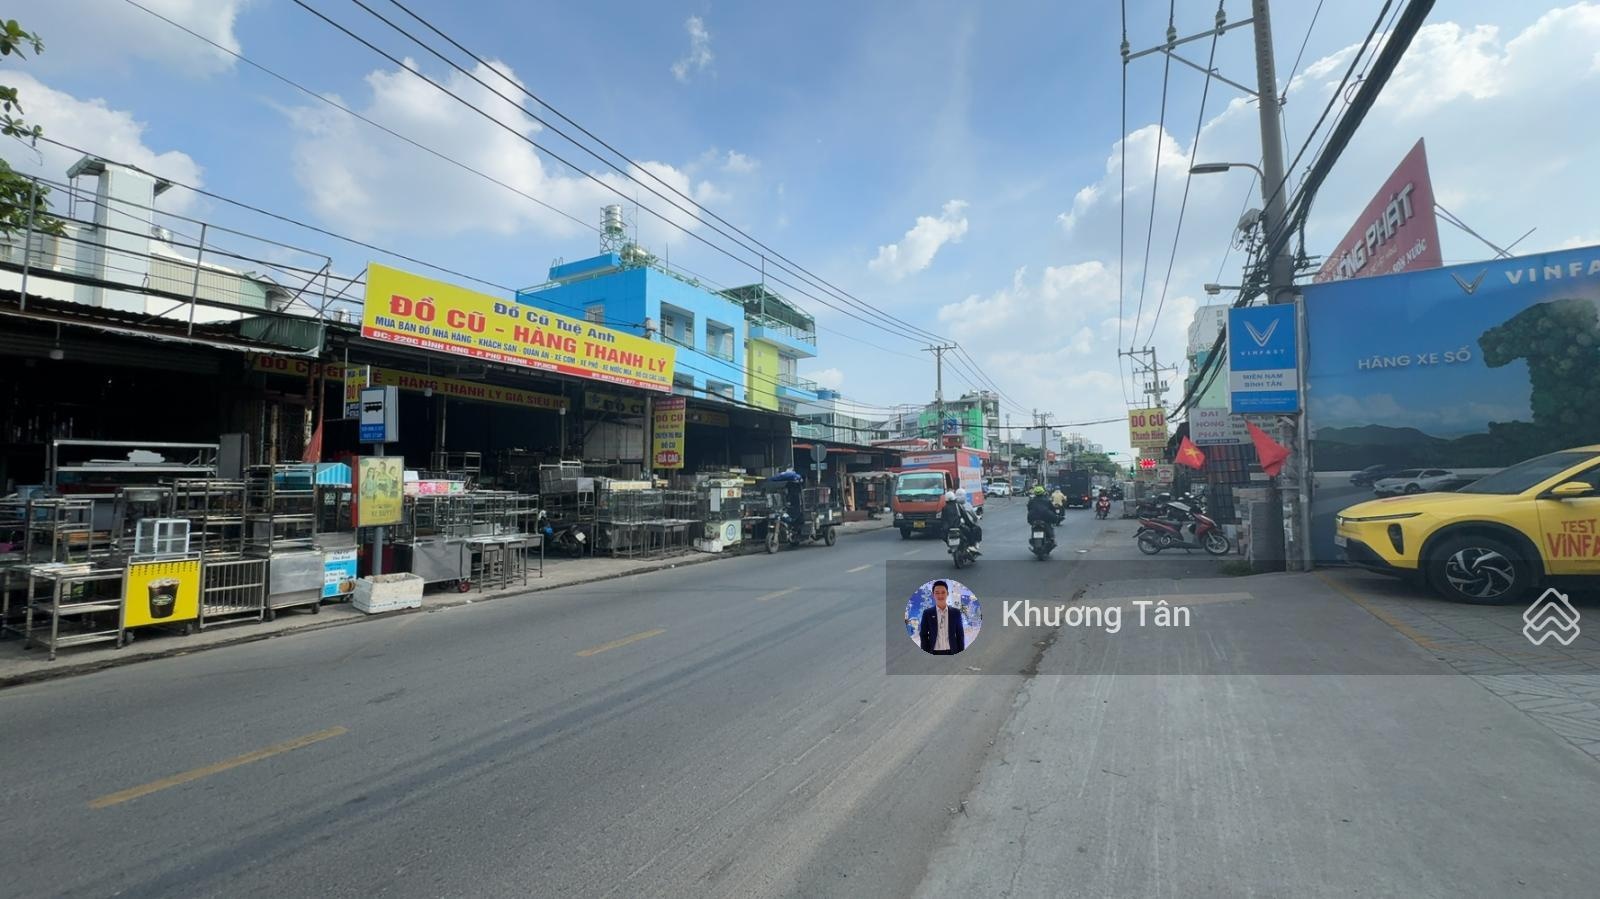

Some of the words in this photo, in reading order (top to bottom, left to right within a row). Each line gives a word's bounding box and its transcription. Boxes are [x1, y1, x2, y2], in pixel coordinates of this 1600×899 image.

[1366, 183, 1413, 256] PHÁT
[375, 316, 395, 329] MUA
[398, 320, 417, 333] BÁN
[390, 295, 436, 322] ĐỒ
[447, 311, 486, 333] CŨ
[514, 325, 577, 354] HÀNG
[584, 341, 644, 369] THANH
[648, 357, 667, 373] LÝ
[555, 318, 582, 336] Tuệ
[587, 328, 615, 343] Anh
[393, 335, 419, 346] 220C
[421, 339, 444, 351] BÌNH
[446, 346, 469, 355] LONG
[1417, 351, 1440, 365] XE
[1443, 344, 1472, 364] SỐ
[442, 382, 485, 396] THANH
[1561, 519, 1597, 534] TEST
